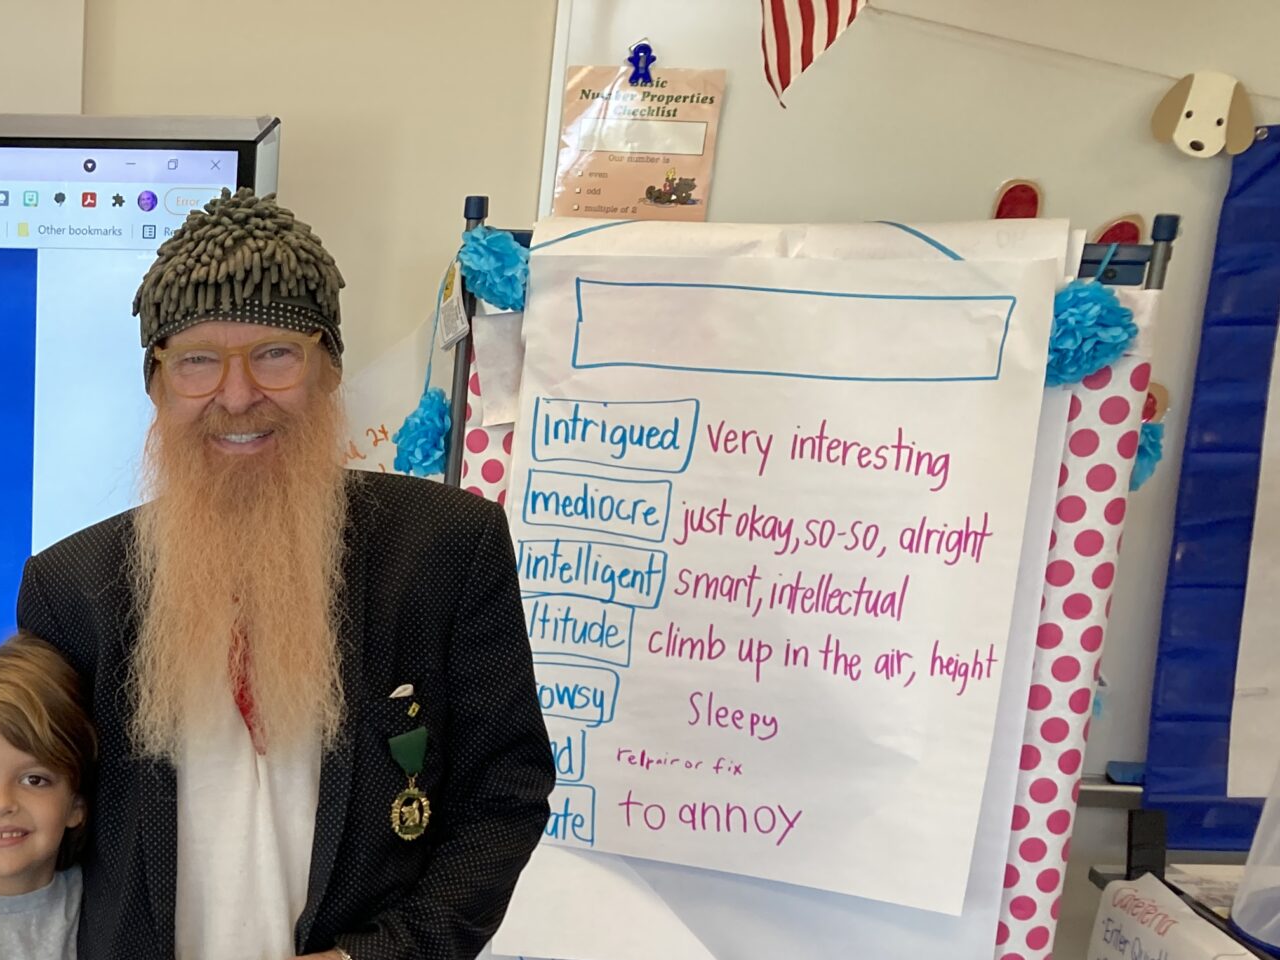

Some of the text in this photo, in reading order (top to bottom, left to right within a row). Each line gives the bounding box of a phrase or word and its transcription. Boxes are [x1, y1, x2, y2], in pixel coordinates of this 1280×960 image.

[640, 91, 716, 105] Properties
[614, 104, 678, 118] Checklist
[627, 154, 659, 164] number
[586, 186, 601, 196] odd
[584, 204, 618, 215] multiple
[620, 205, 630, 214] of
[37, 225, 123, 237] Other bookmarks
[790, 420, 951, 492] interesting
[531, 483, 661, 528] mediocre
[673, 498, 733, 546] just
[899, 512, 994, 566] alright
[525, 537, 910, 621] intelligent smart, intellectual
[529, 601, 999, 696] ltitude climb up in the air, height
[538, 681, 779, 740] owsy Sleepy
[684, 756, 744, 776] or fix
[618, 789, 665, 834] to
[678, 803, 804, 847] annoy
